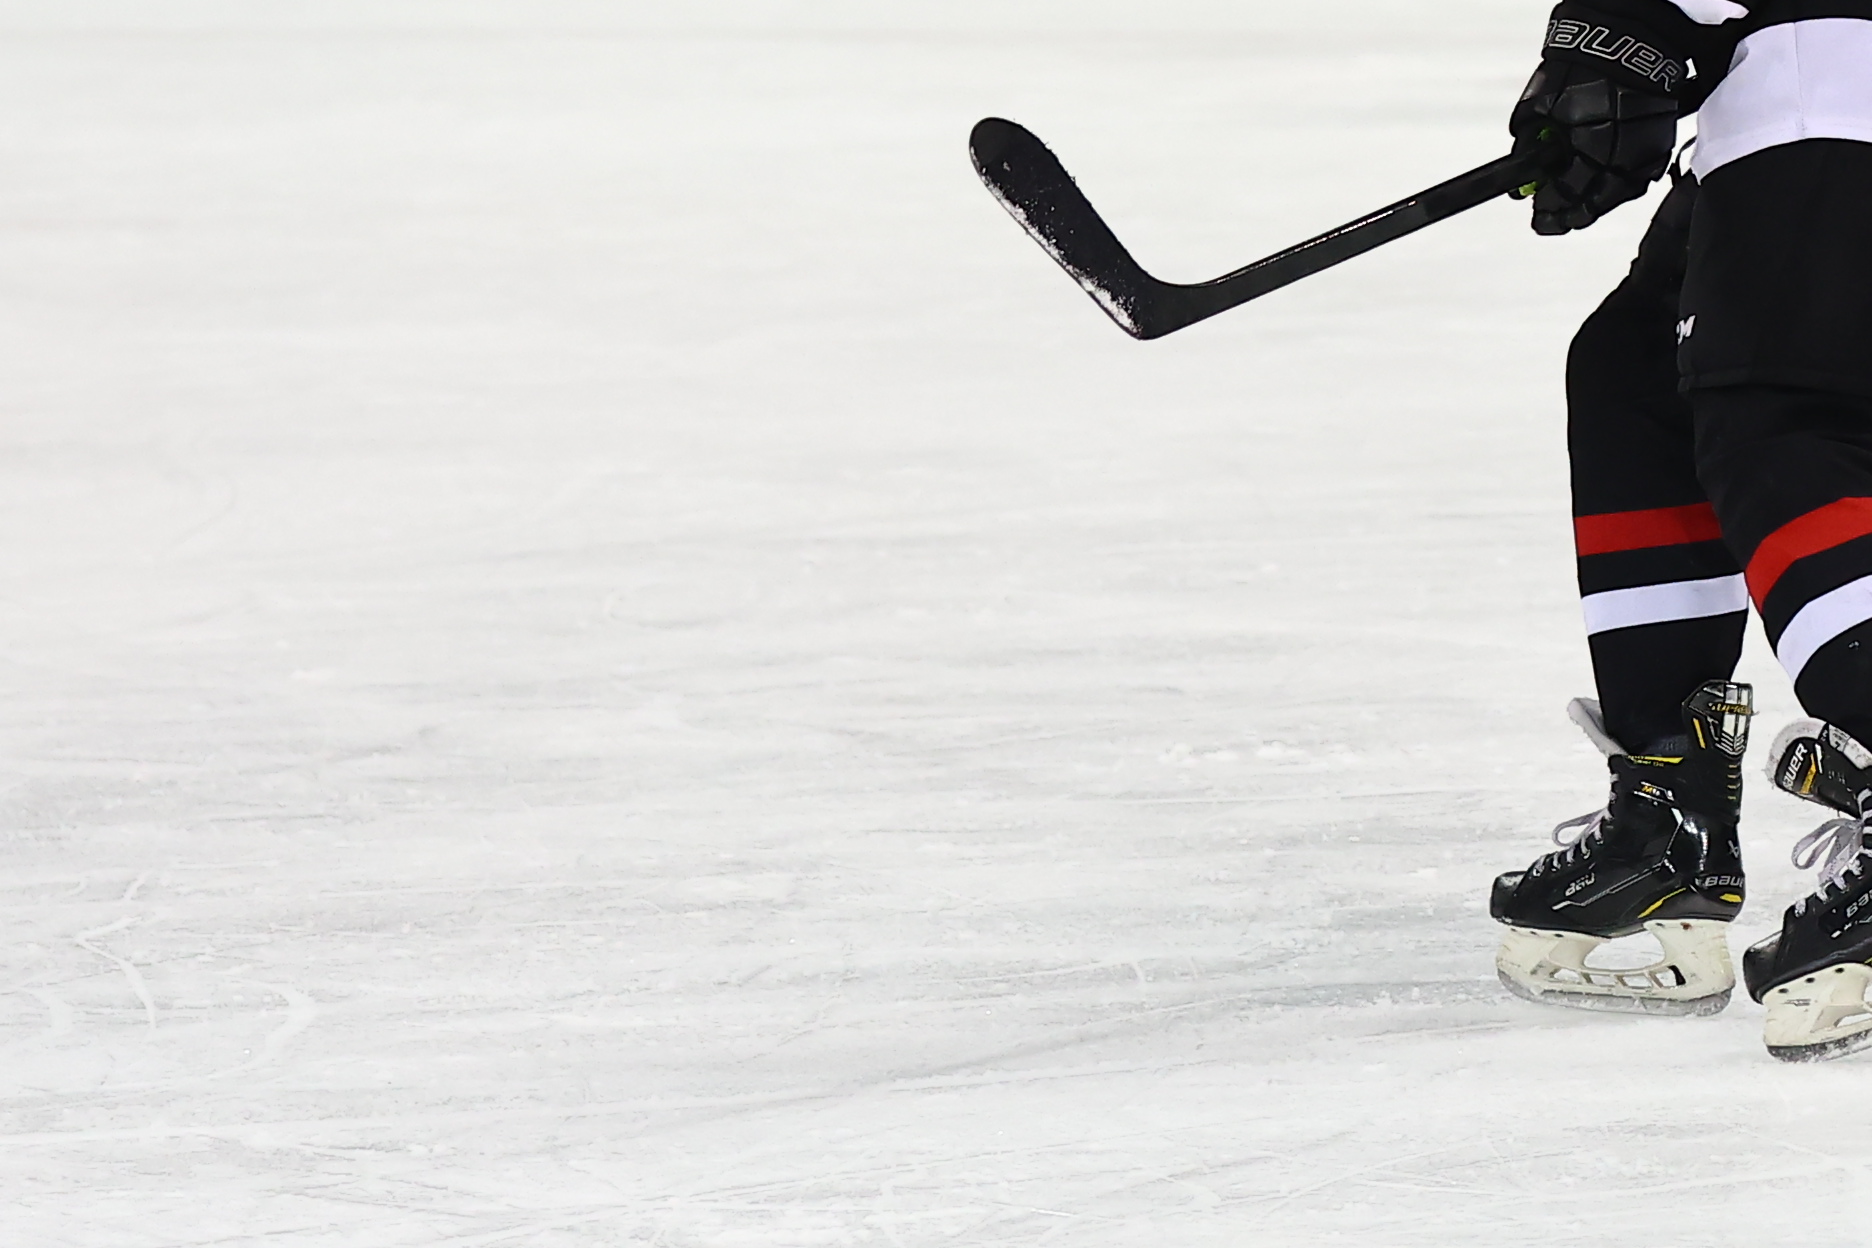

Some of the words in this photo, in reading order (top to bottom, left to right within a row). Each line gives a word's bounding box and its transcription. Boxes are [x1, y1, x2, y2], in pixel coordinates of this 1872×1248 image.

[1676, 315, 1696, 345] M
[1782, 742, 1808, 790] AUER
[1704, 874, 1744, 888] BAU
